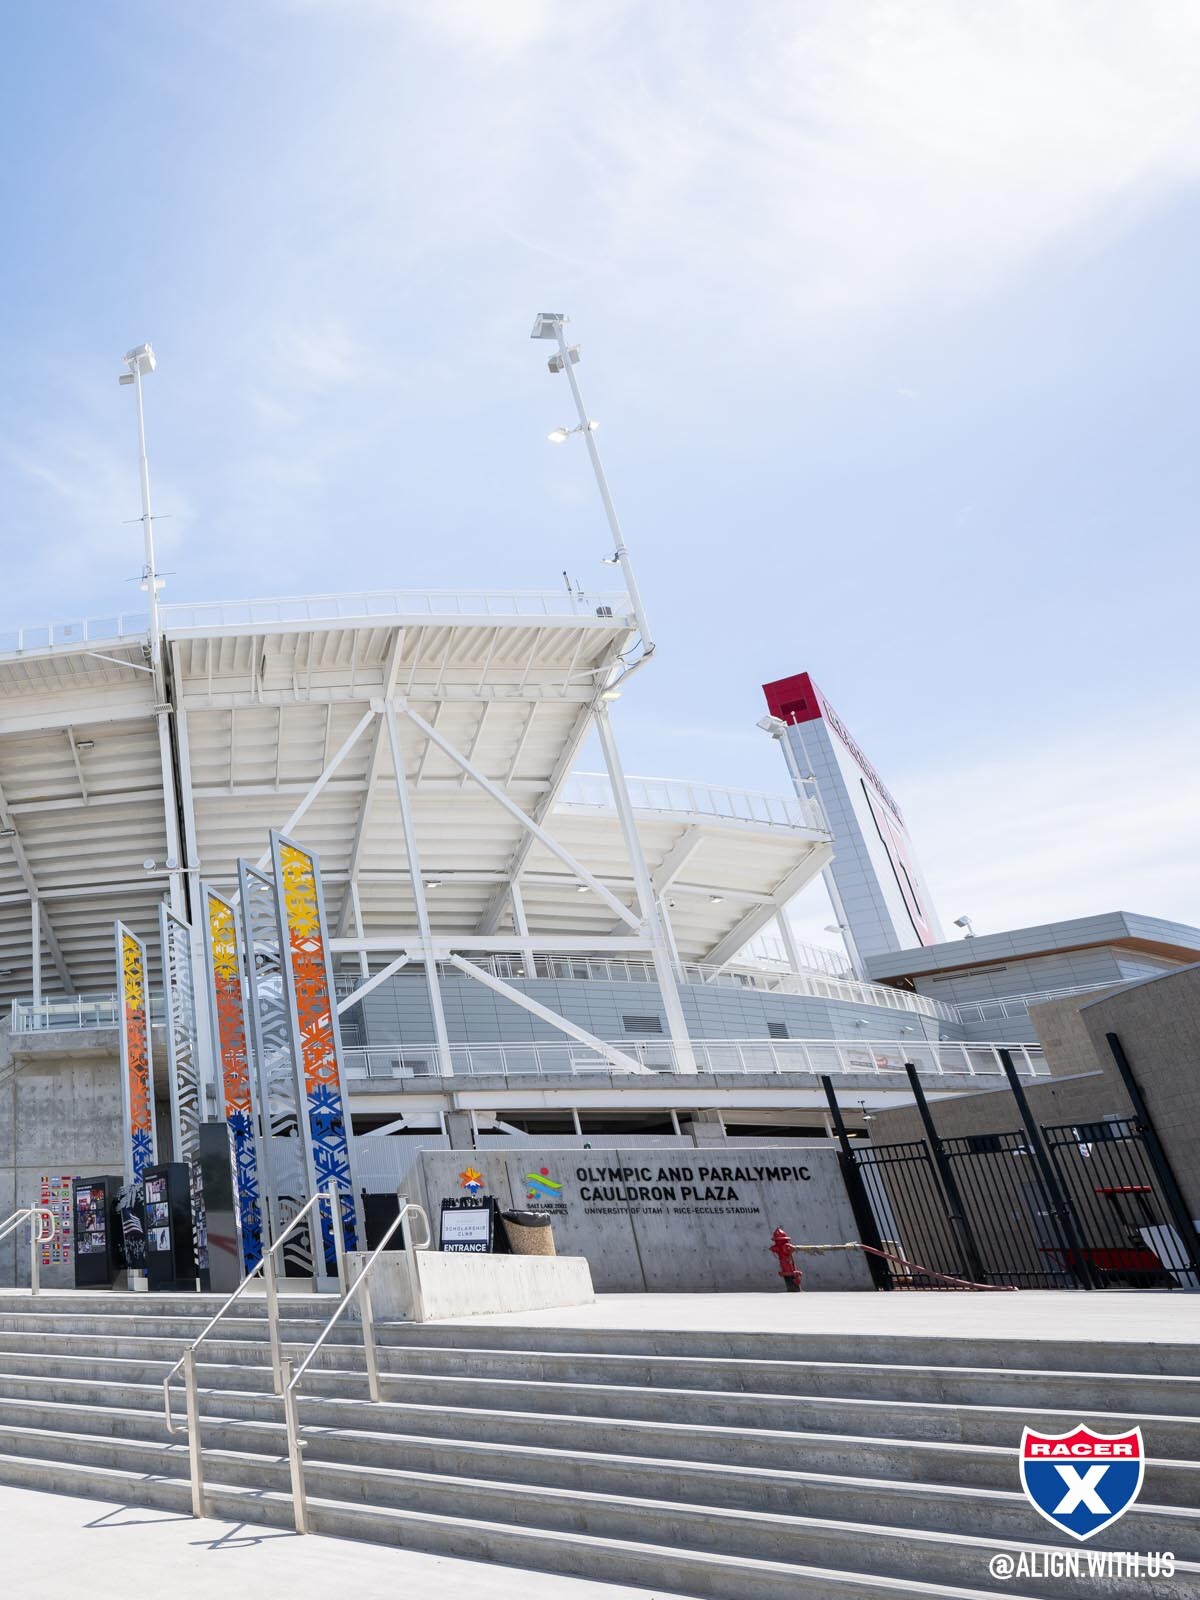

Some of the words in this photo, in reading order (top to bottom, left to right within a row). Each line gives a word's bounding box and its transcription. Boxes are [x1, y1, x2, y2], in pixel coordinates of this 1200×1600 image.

[576, 1167, 652, 1182] OLYMPIC
[657, 1167, 694, 1182] AND
[700, 1166, 811, 1182] PARALYMPIC
[579, 1186, 677, 1202] CAULDRON
[681, 1186, 740, 1201] PLAZA
[584, 1207, 629, 1215] UNIVERSITY
[630, 1207, 640, 1215] OF
[642, 1207, 663, 1215] UTAH
[673, 1207, 725, 1215] RICE-ECCLES
[726, 1207, 760, 1215] STADIUM
[443, 1243, 487, 1253] ENTRANCE
